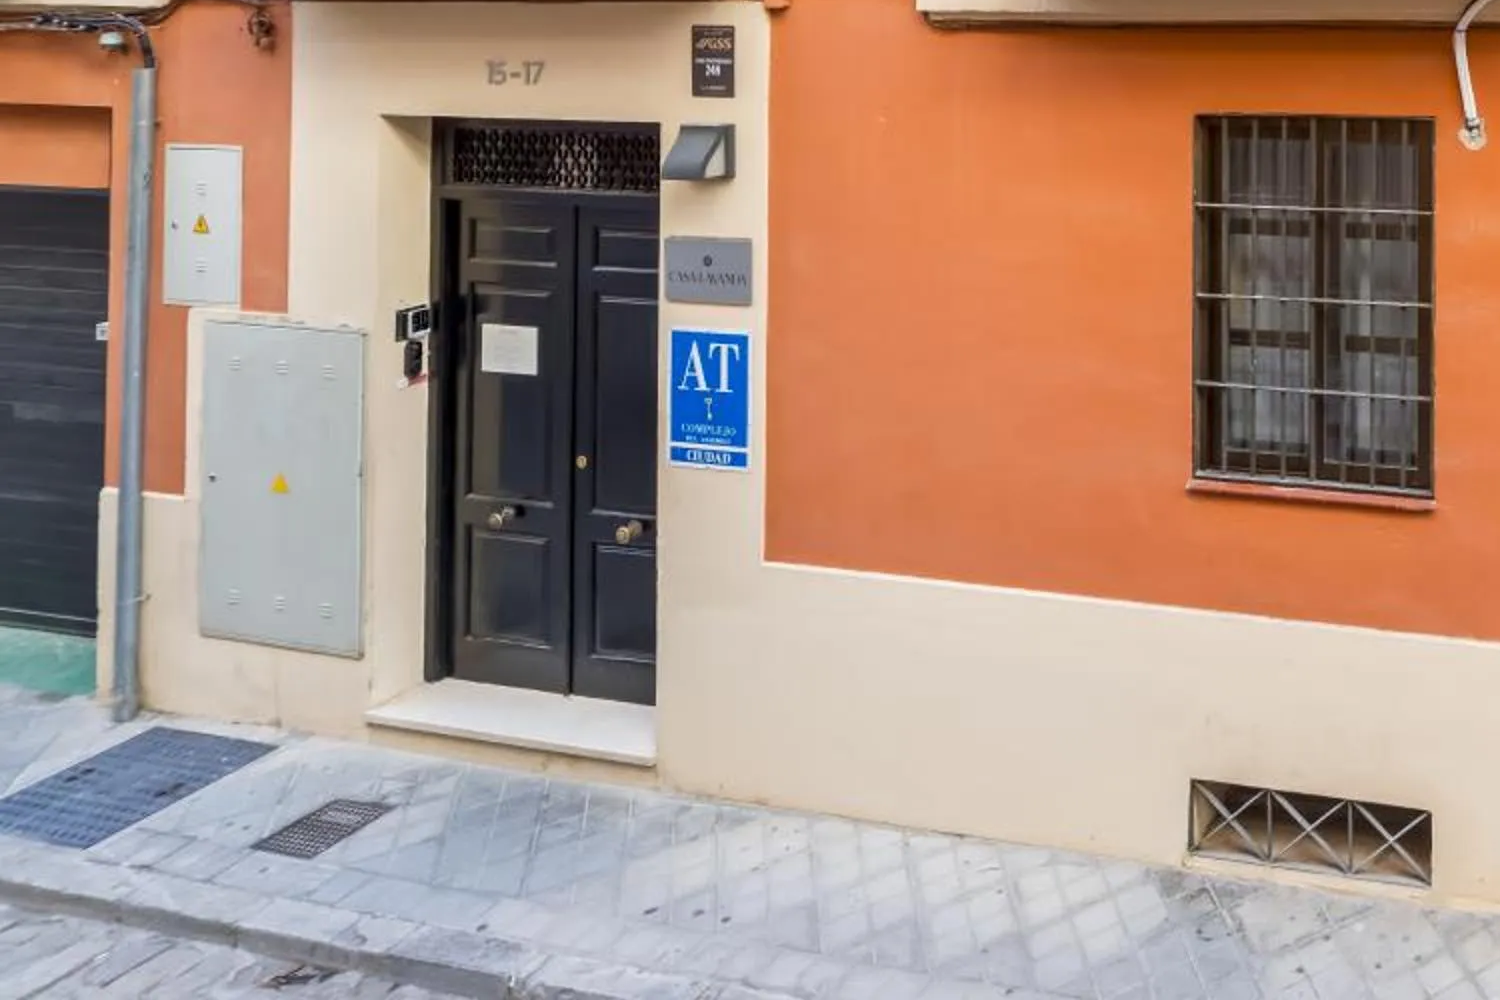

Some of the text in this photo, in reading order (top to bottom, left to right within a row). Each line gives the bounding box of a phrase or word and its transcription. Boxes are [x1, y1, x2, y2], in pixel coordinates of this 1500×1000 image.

[485, 60, 545, 85] 15-17
[677, 339, 740, 393] AT
[687, 449, 731, 464] CIUDAD
